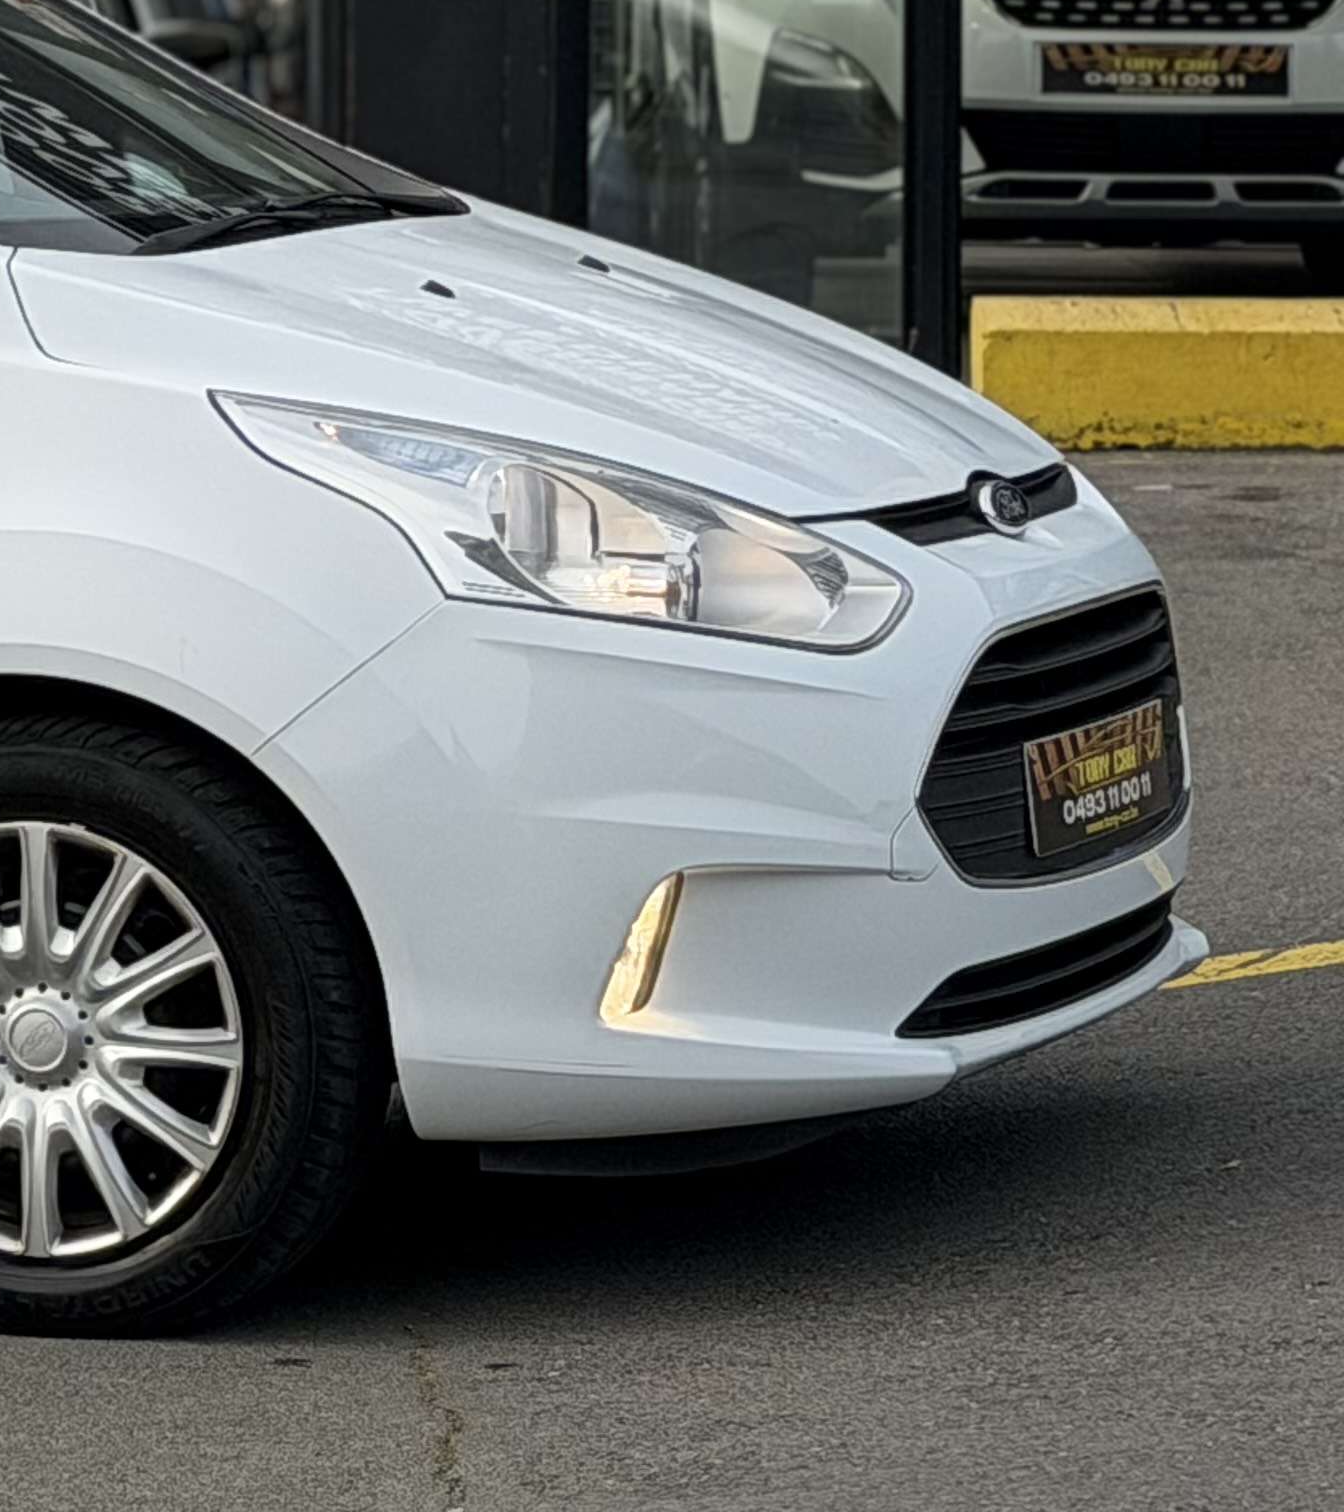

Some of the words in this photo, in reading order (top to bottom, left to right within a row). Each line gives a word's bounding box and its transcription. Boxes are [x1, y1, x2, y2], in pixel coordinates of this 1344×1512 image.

[1083, 71, 1153, 87] 0493
[1159, 72, 1177, 87] 11
[1182, 73, 1221, 88] 00
[1225, 73, 1247, 88] 11
[1063, 792, 1106, 825] 0493
[1107, 785, 1120, 809] 11
[1120, 778, 1141, 805] 00
[1140, 771, 1153, 797] 11
